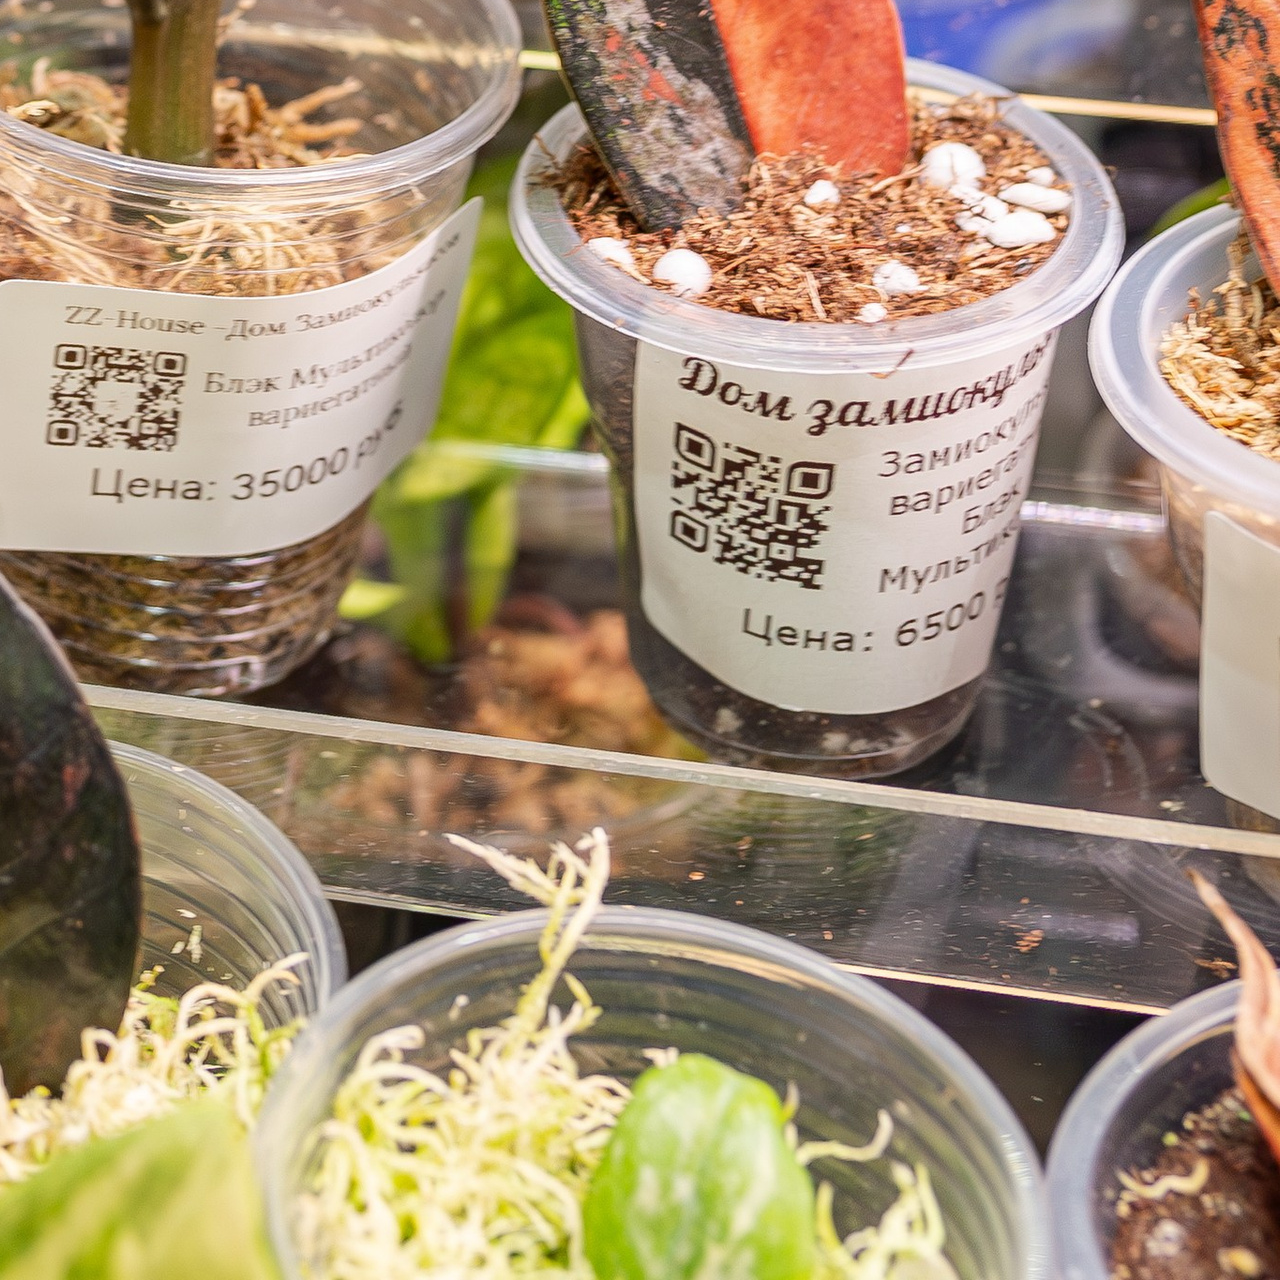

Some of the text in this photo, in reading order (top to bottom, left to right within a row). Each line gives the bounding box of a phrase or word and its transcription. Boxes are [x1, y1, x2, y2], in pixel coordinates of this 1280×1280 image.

[65, 305, 205, 336] ZZ-House
[203, 371, 281, 395] Блэк
[678, 356, 795, 422] Дом
[91, 397, 404, 503] Цена: 35000 руб
[740, 607, 874, 653] Цена:
[894, 591, 986, 647] 6500
